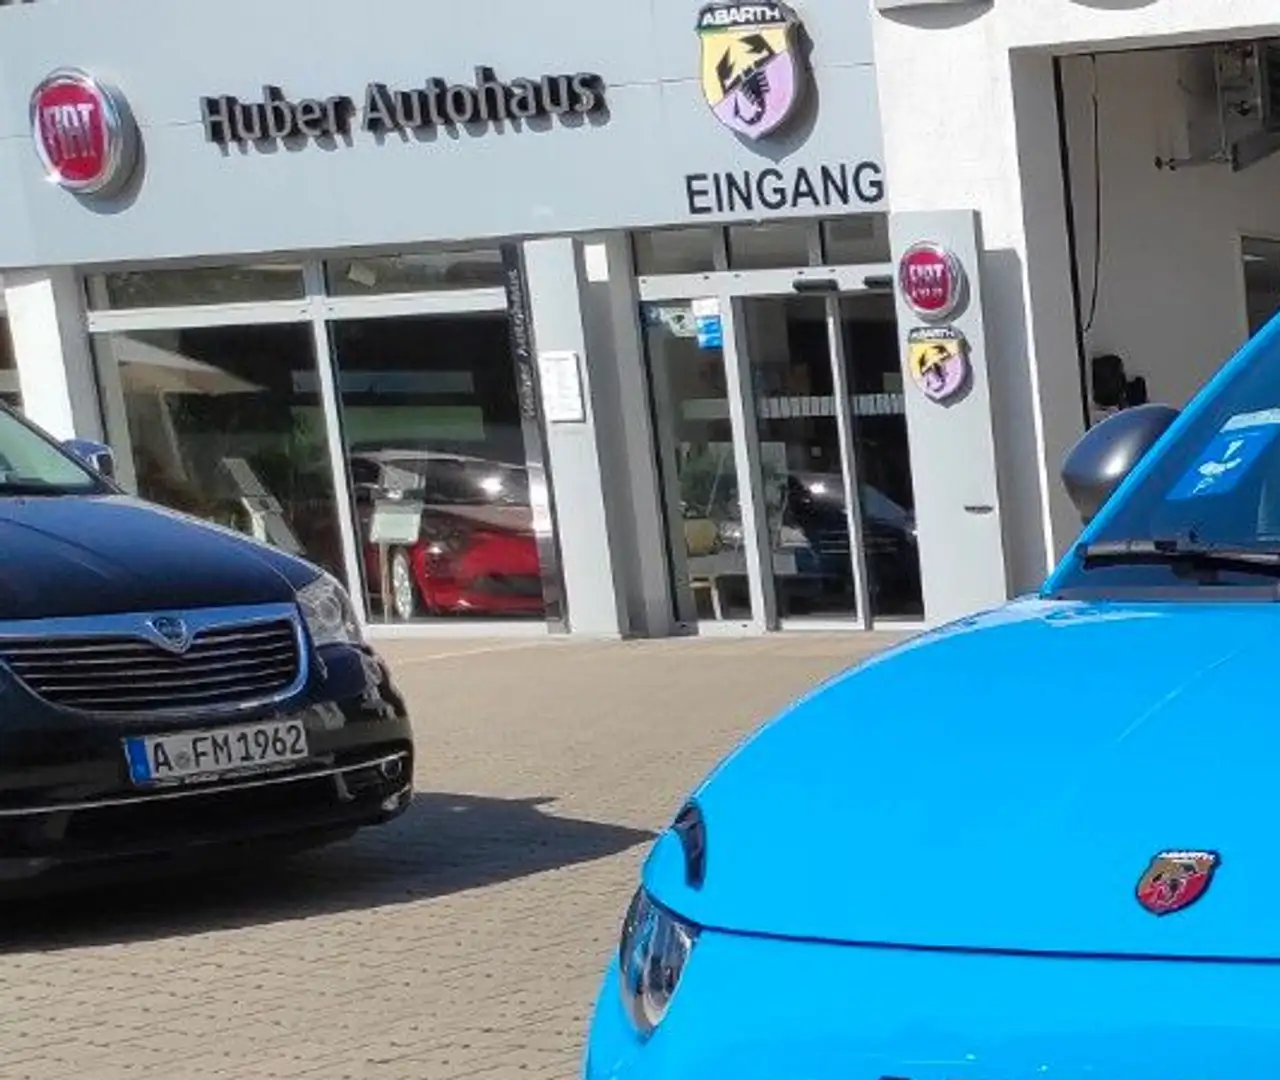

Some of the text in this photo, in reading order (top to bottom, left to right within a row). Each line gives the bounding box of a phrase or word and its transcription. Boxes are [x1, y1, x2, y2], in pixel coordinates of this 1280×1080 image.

[702, 6, 781, 26] ABARTH
[200, 65, 608, 143] Huber Autohaus
[41, 102, 98, 160] FIAT
[685, 161, 885, 214] EINGANG
[153, 742, 174, 773] A
